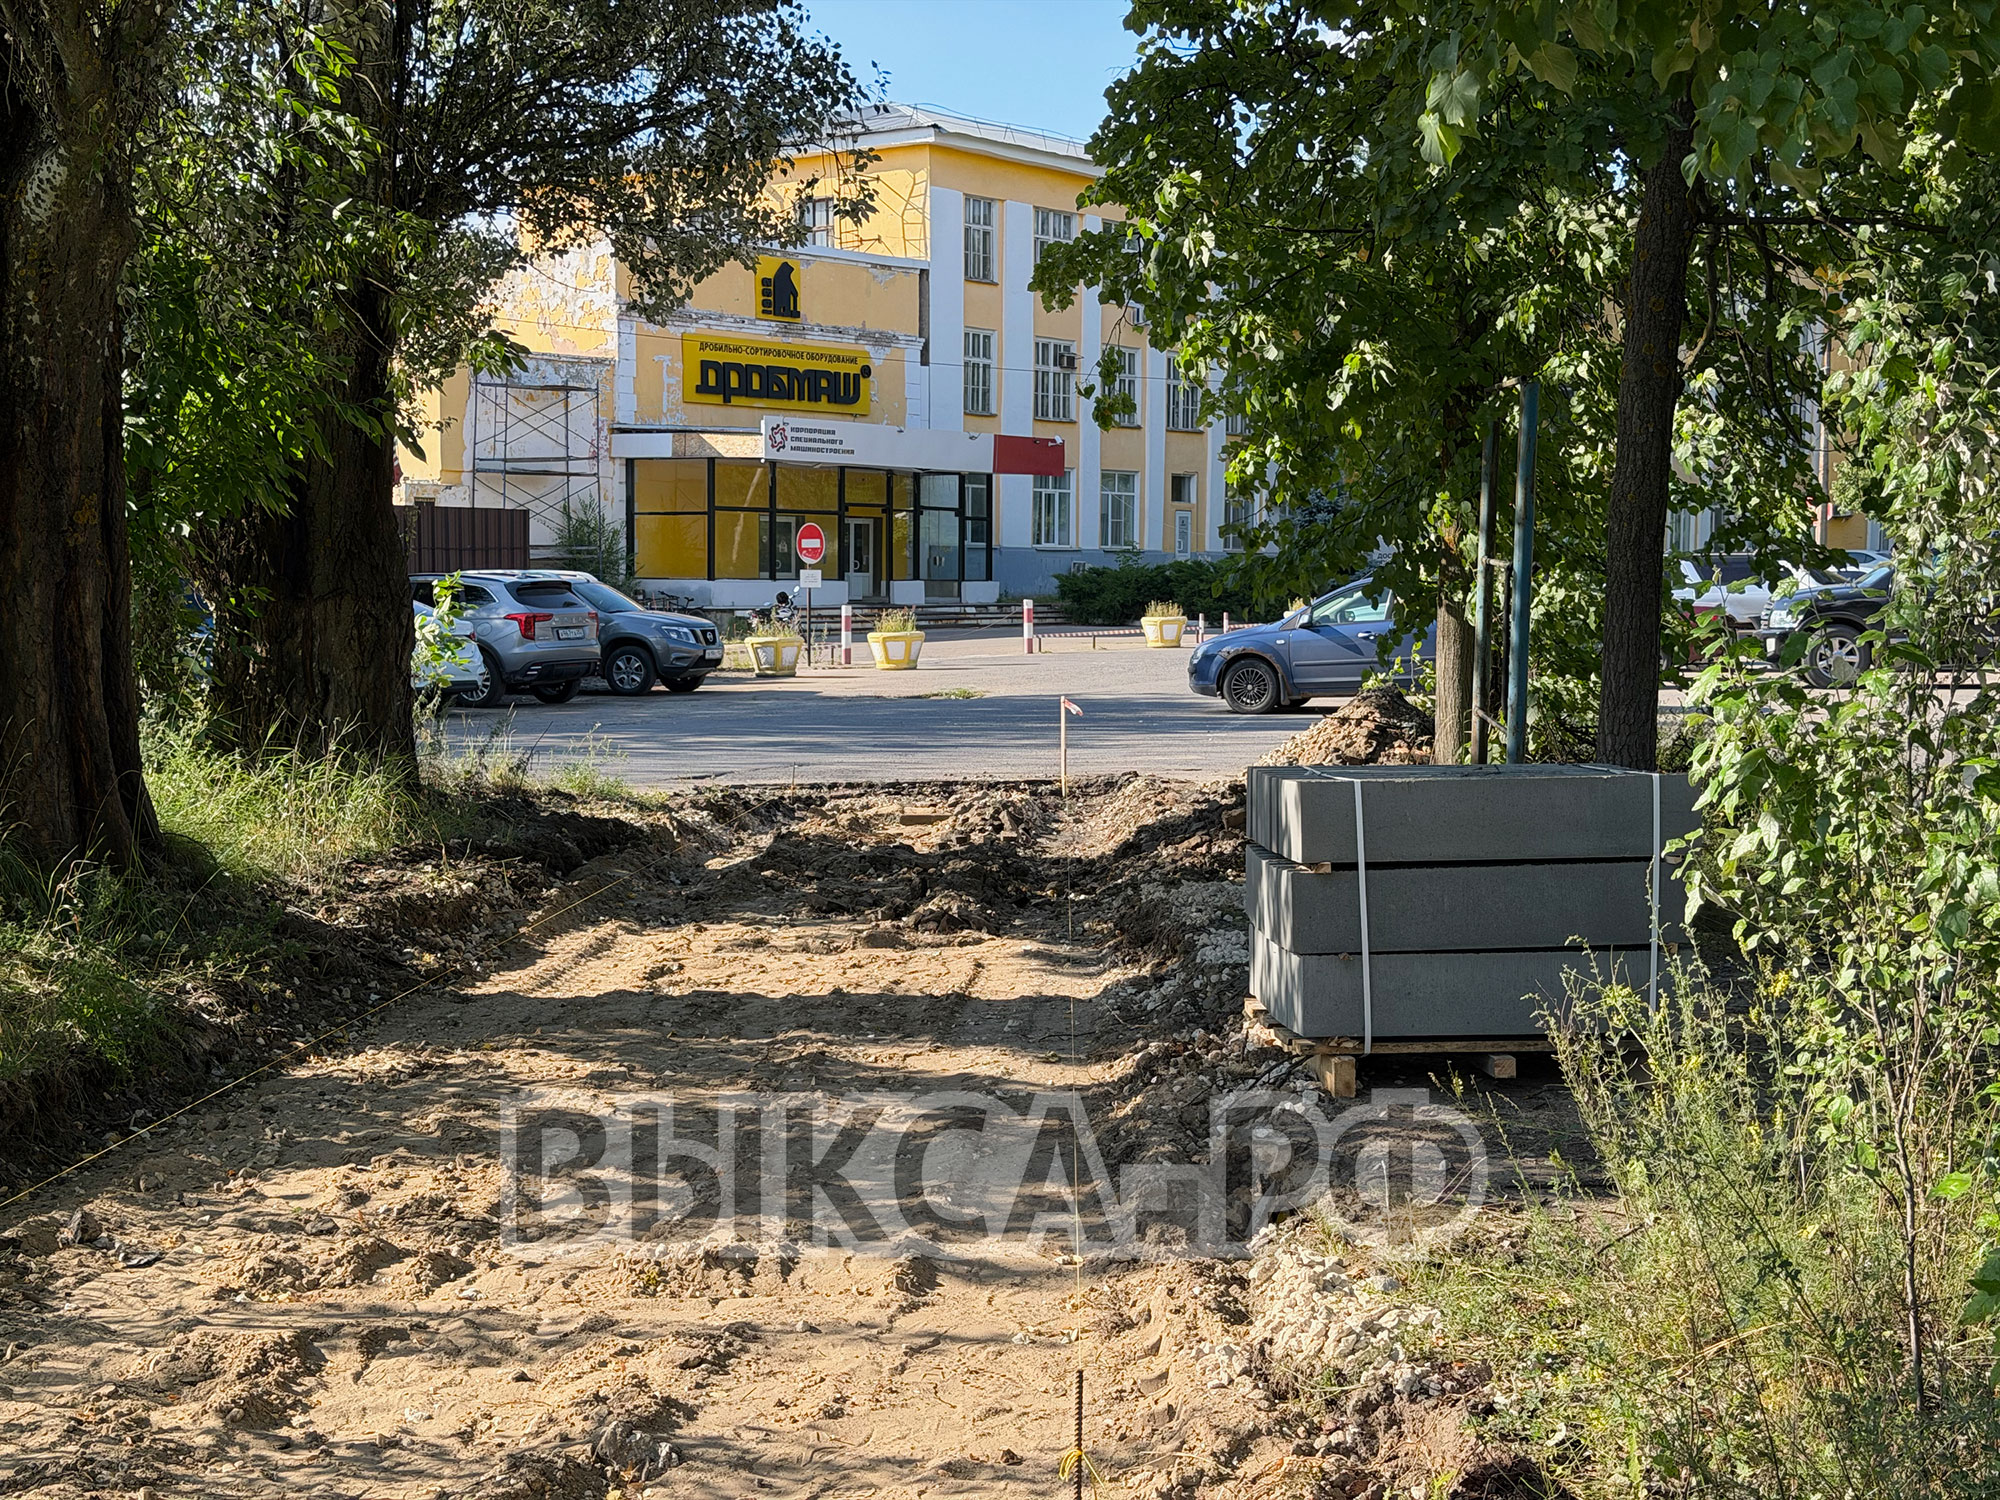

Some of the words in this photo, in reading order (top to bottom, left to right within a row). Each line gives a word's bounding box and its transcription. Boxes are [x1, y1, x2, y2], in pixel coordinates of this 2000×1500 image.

[699, 342, 805, 359] ДРОБИЛЬНО-СОРТИРОВОЧНОЕ
[806, 352, 859, 365] ОБОРУДОВАНИЕ
[696, 359, 861, 406] ДРОБМАШ
[790, 427, 836, 435] КОРПОРАЦИЯ
[790, 436, 844, 445] СПЕЦИАЛЬНОГО
[790, 446, 855, 455] МАШИНОСТРОЕНИЯ
